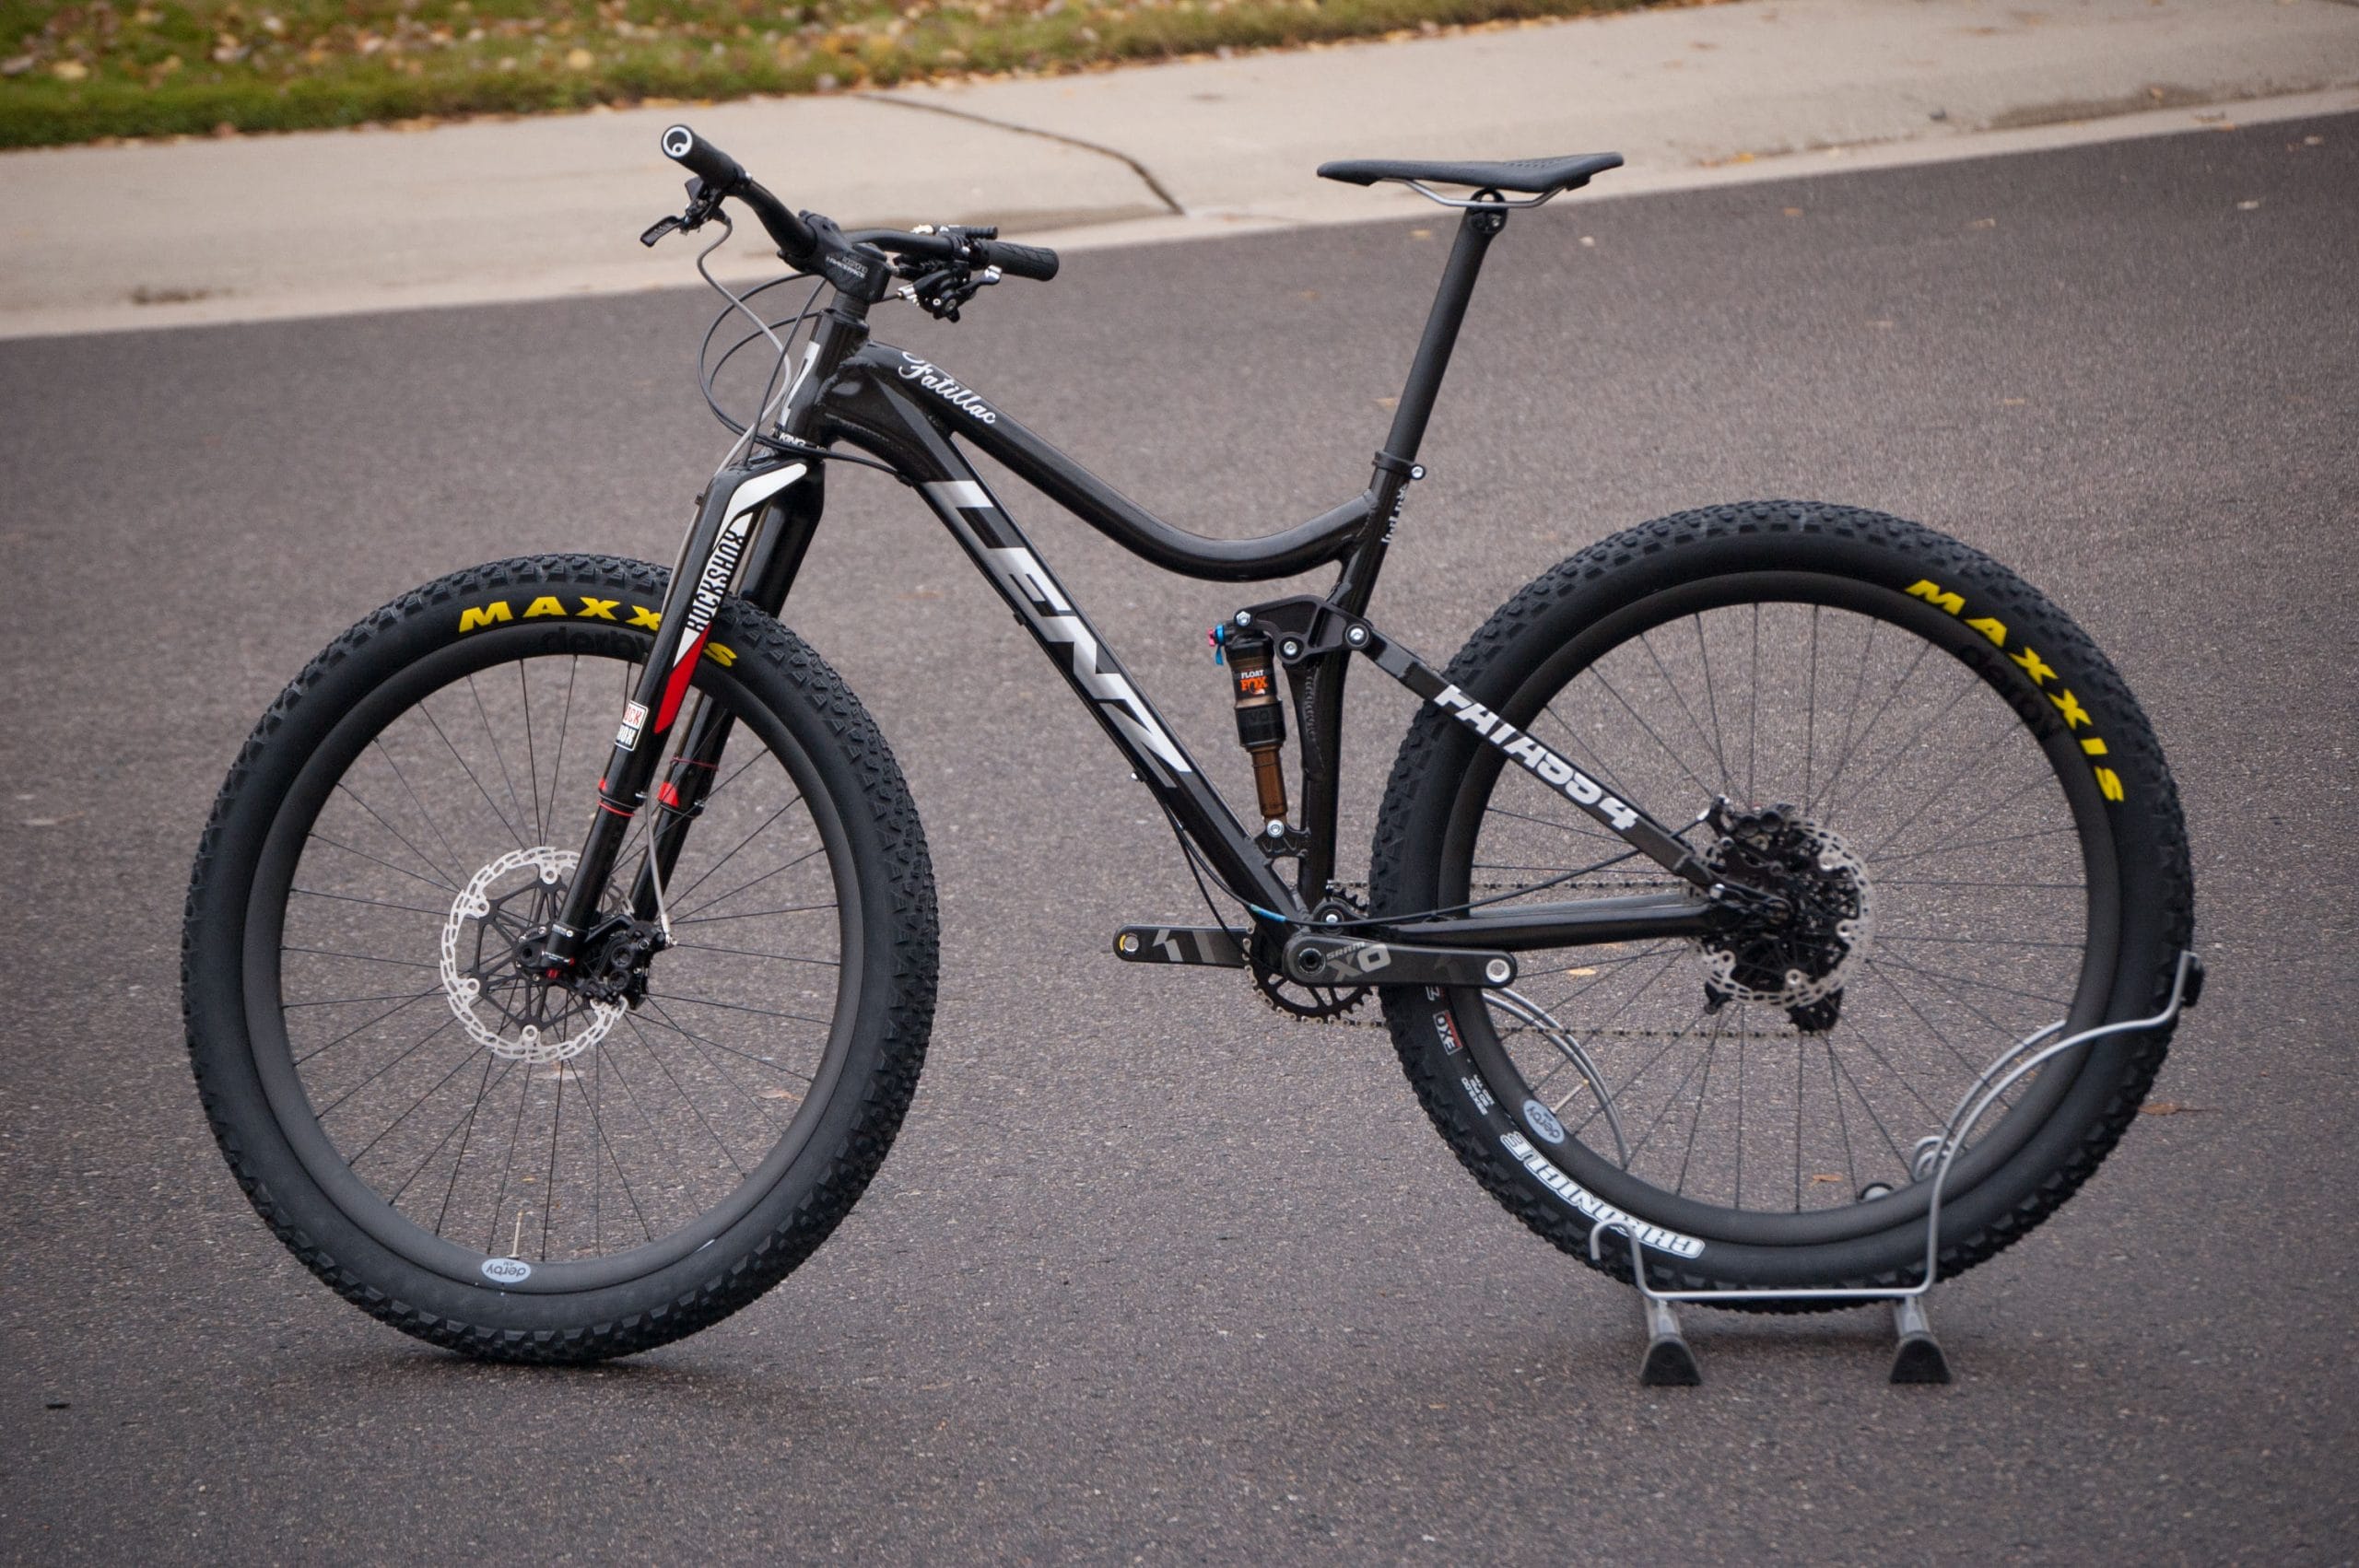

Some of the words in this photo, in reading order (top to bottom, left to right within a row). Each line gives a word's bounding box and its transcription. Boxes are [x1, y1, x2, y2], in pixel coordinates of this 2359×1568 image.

[898, 352, 996, 424] Fatillac
[685, 530, 745, 634] ROCKSHOX
[459, 596, 738, 667] MAXXS
[922, 480, 1192, 788] LENZ
[1240, 675, 1268, 695] FOX
[1241, 670, 1263, 679] FLOAT
[1904, 579, 2124, 802] MAXXIS
[1327, 942, 1365, 960] SRAM
[1435, 1012, 1459, 1052] EXO
[486, 1263, 526, 1277] derby
